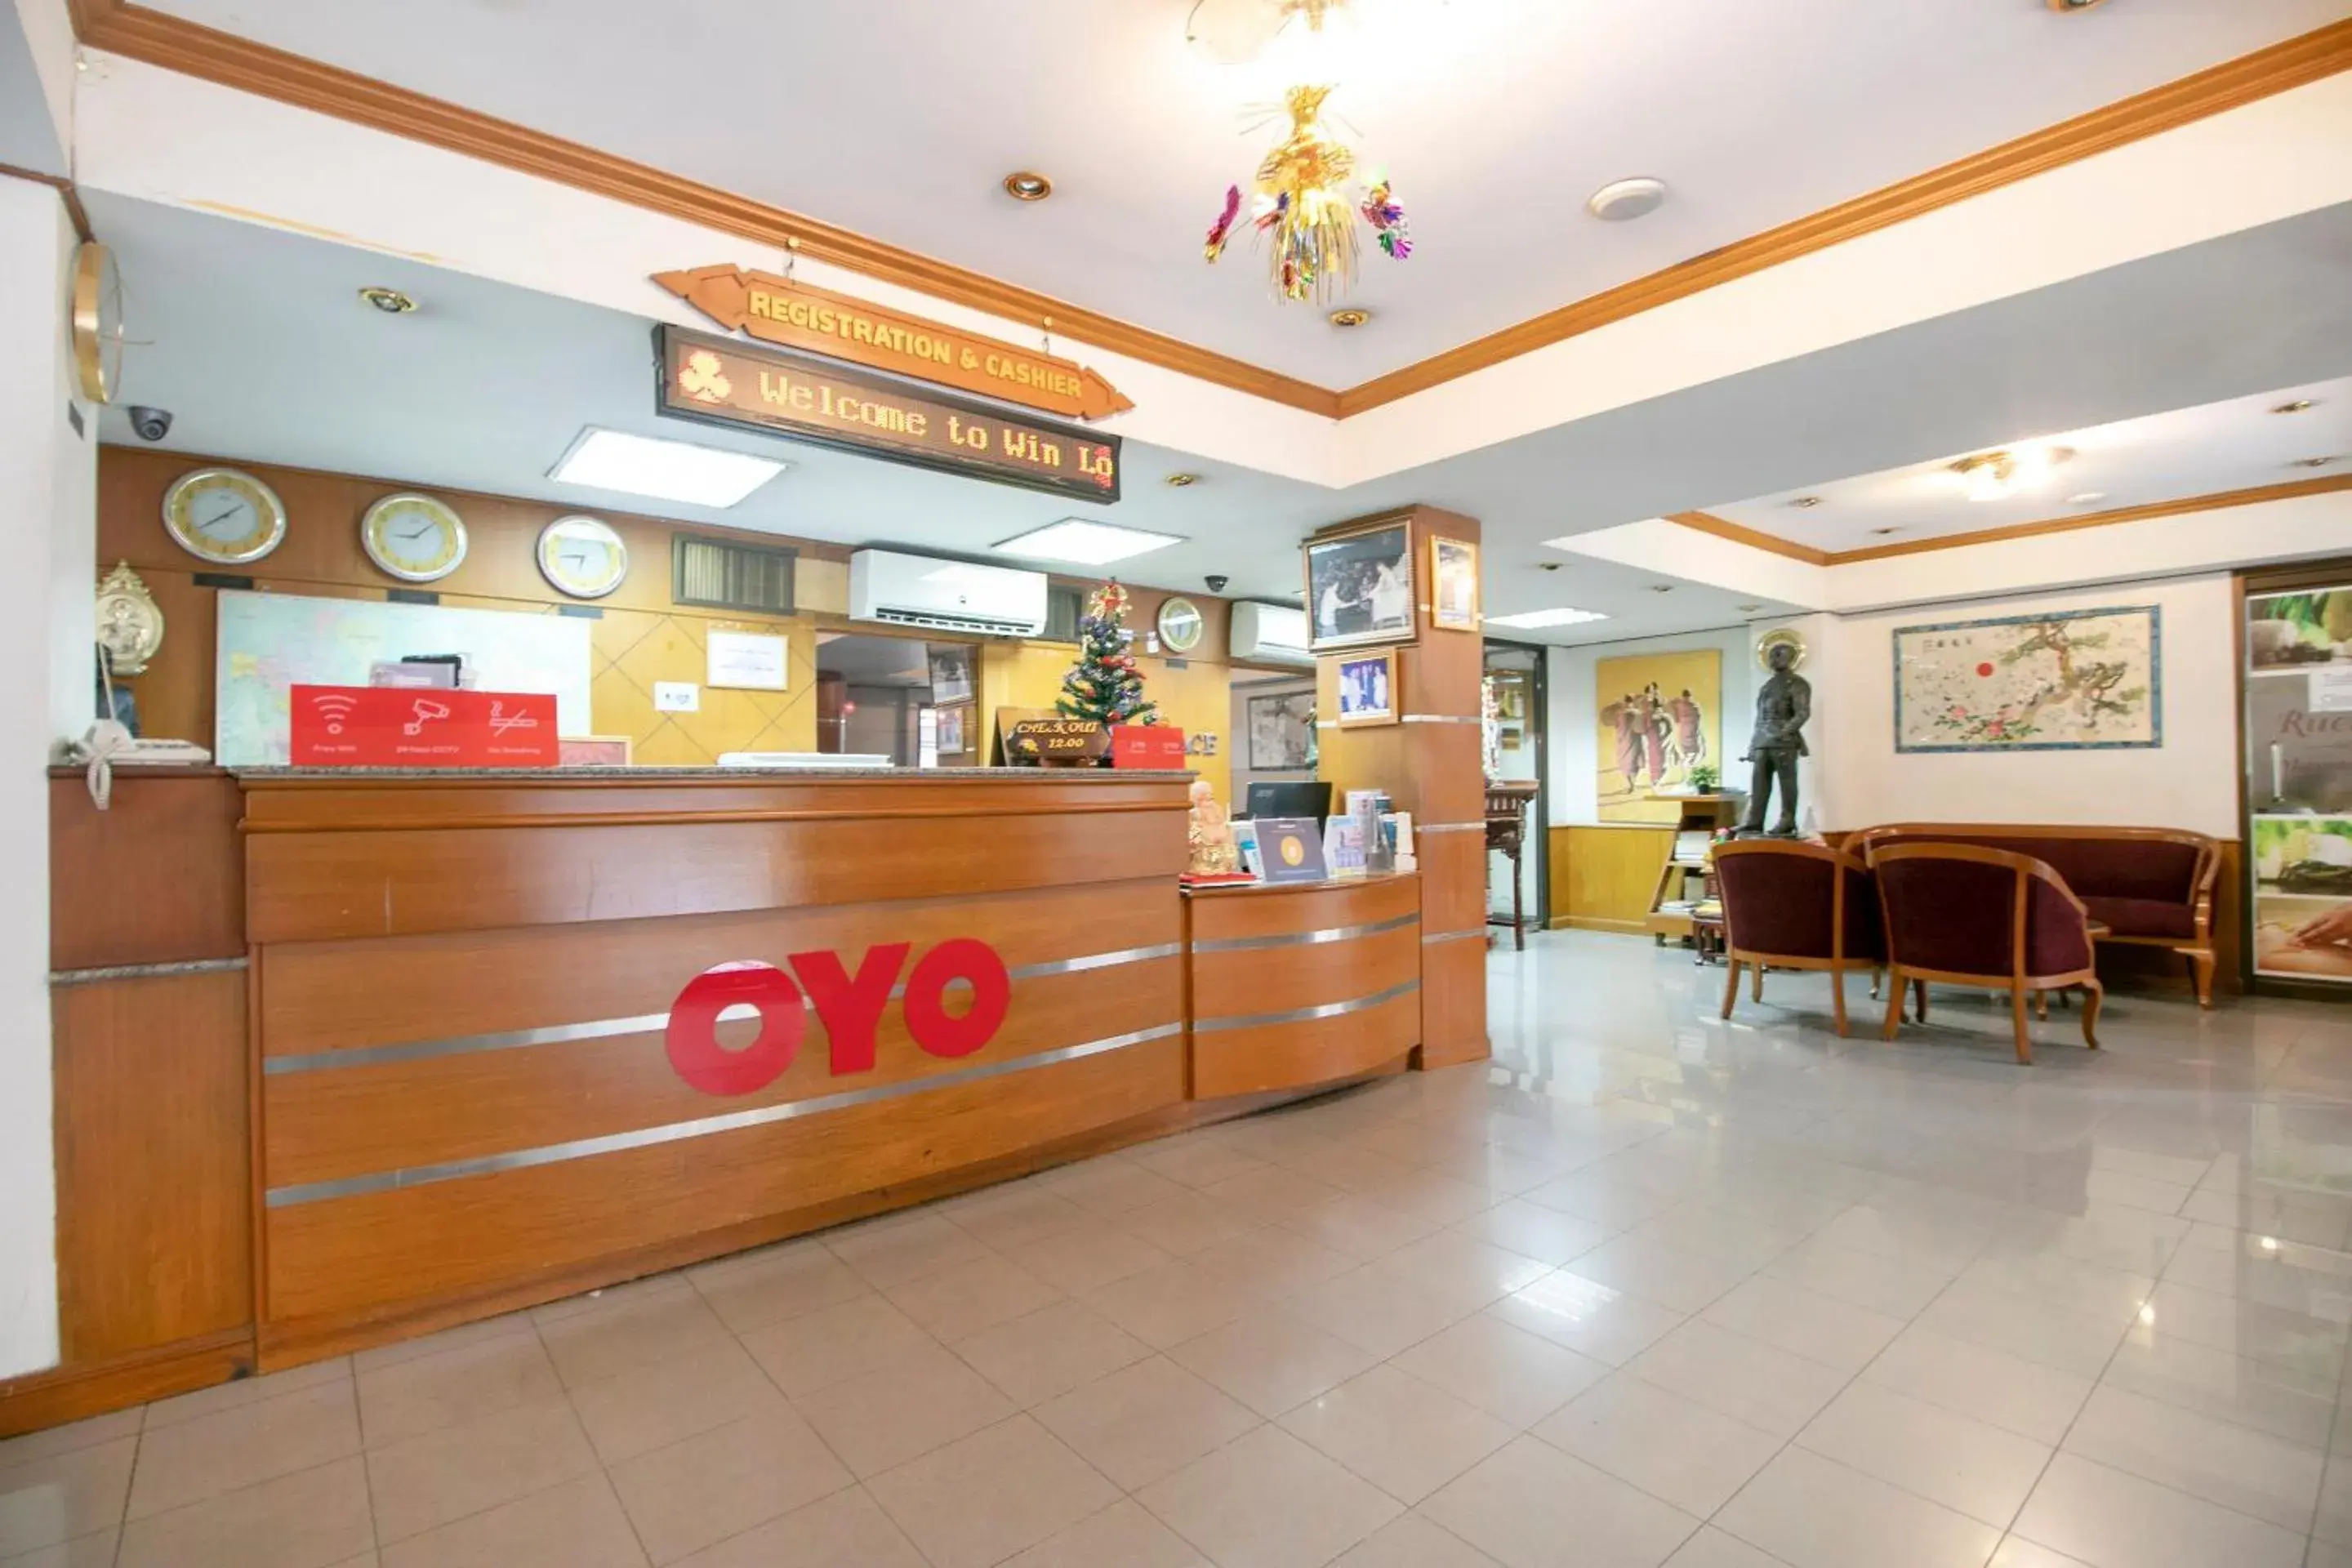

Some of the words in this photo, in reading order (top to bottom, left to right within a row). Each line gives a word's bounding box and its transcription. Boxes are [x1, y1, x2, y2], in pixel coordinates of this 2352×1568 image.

[749, 291, 951, 364] REGISTRATION
[960, 348, 979, 371] &
[985, 354, 1082, 399] CASHIER
[759, 371, 927, 437] Welcome
[947, 416, 987, 450] to
[1004, 428, 1061, 467] Win
[1017, 721, 1068, 734] CHECK
[1068, 720, 1098, 733] OUT
[1048, 737, 1085, 749] 12.00
[665, 937, 1011, 1097] OYO
